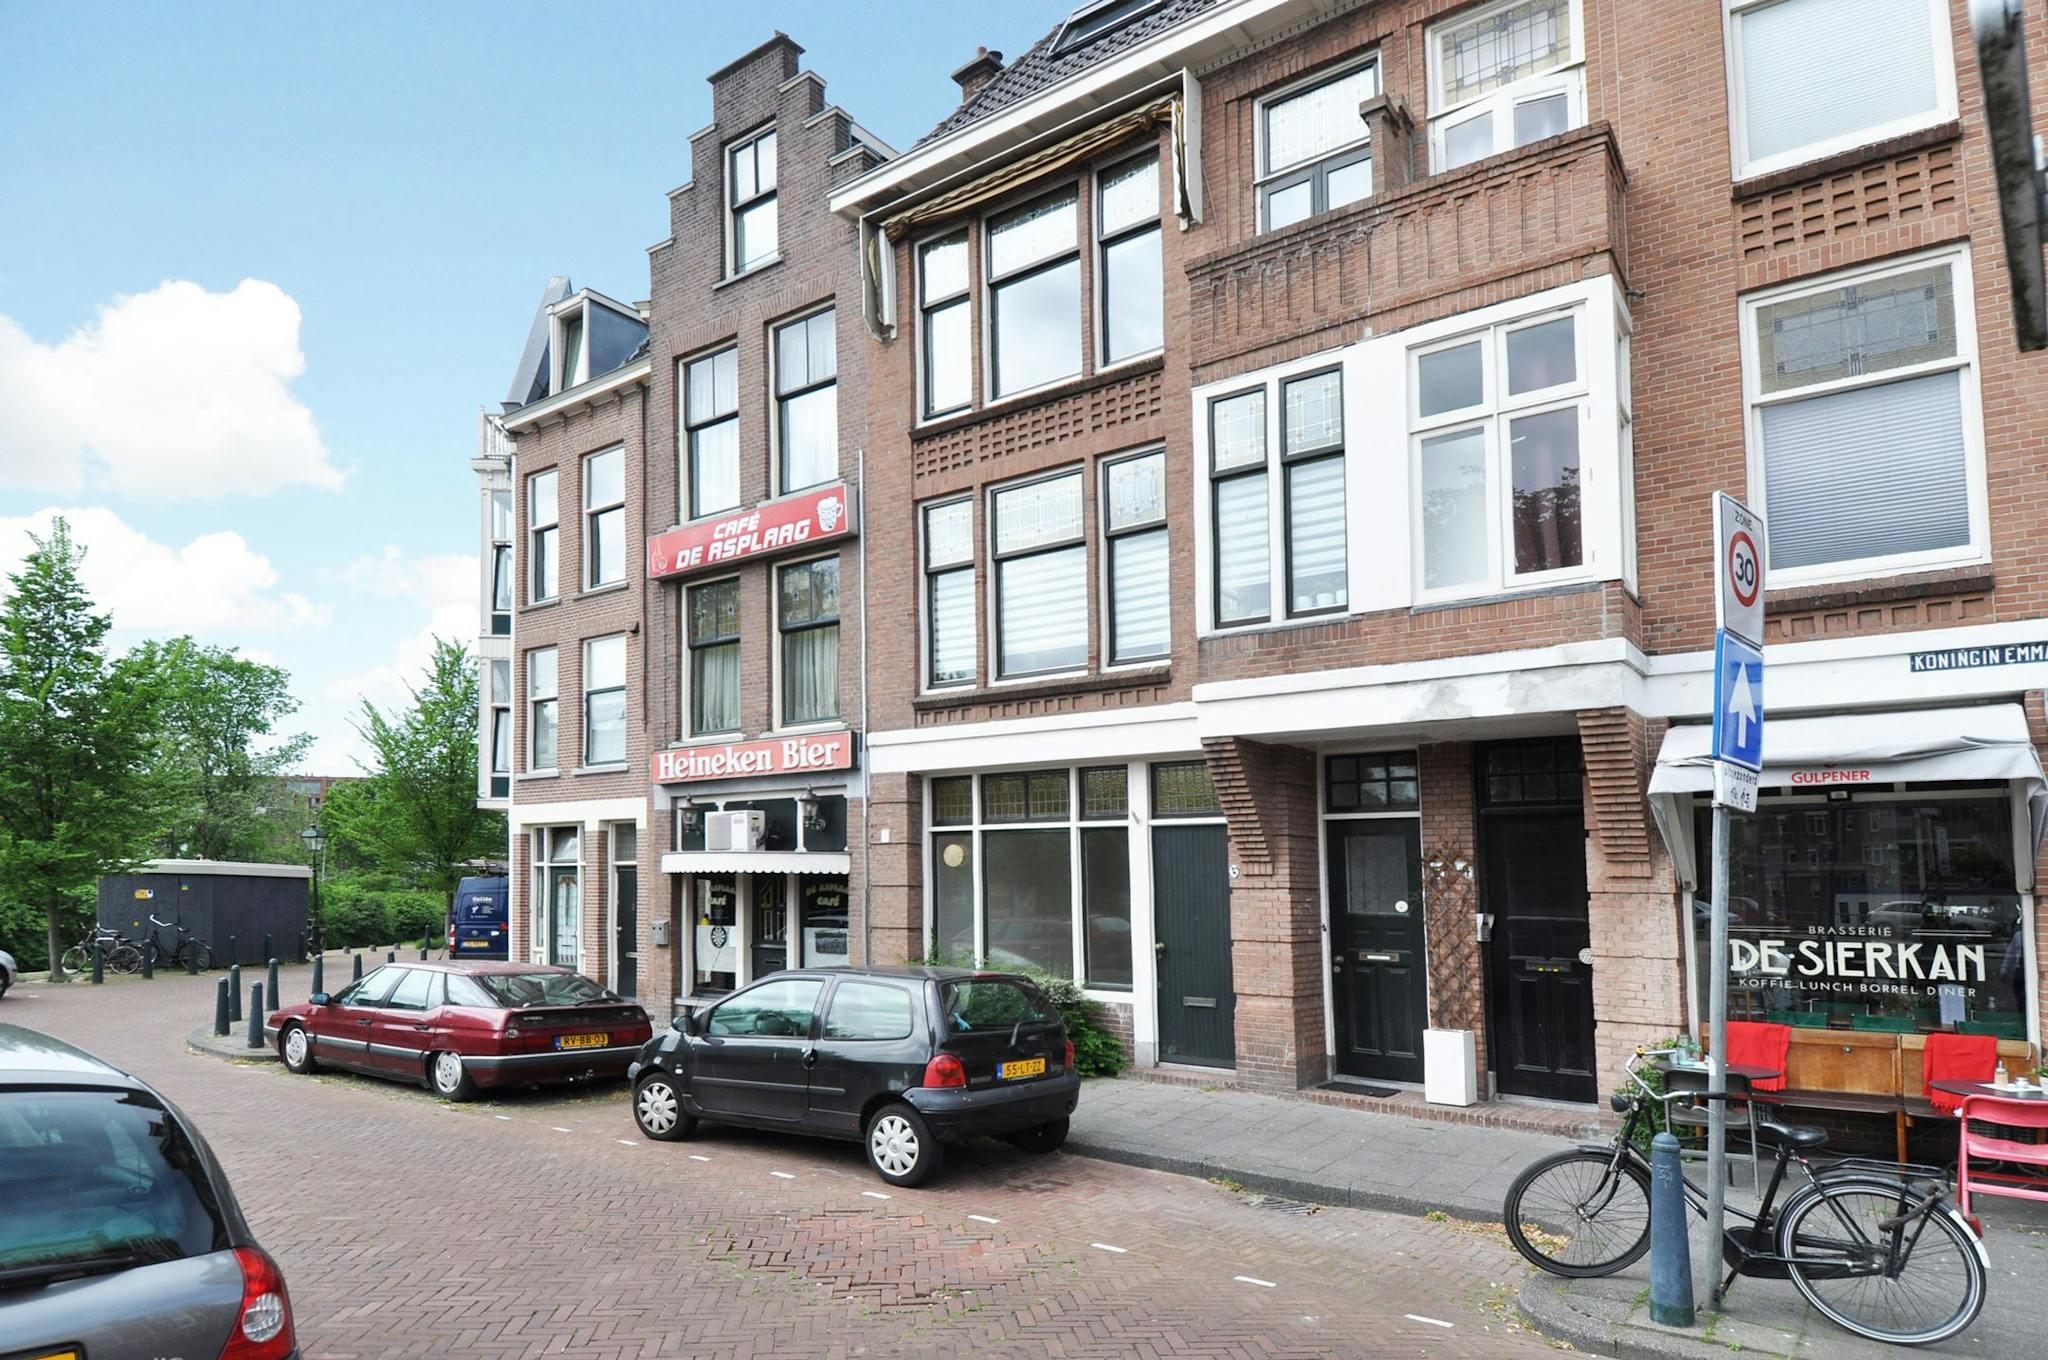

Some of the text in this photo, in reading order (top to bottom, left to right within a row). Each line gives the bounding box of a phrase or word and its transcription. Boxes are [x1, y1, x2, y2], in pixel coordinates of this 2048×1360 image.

[712, 511, 760, 540] CAFÉ
[1734, 510, 1753, 531] ZONE
[675, 518, 811, 569] DE ASPLAAG
[1735, 552, 1755, 586] 30
[1914, 644, 2048, 671] KONINGIN EMM
[658, 738, 840, 780] Heineken Bier
[1791, 769, 1870, 784] GULPENER
[1808, 925, 1892, 937] BRASSERIE
[1739, 978, 1977, 997] KOFFIE LUNCH BORREL DINER
[563, 1035, 605, 1046] RV-BB-03
[1006, 1060, 1041, 1076] 55-LT-ZZ
